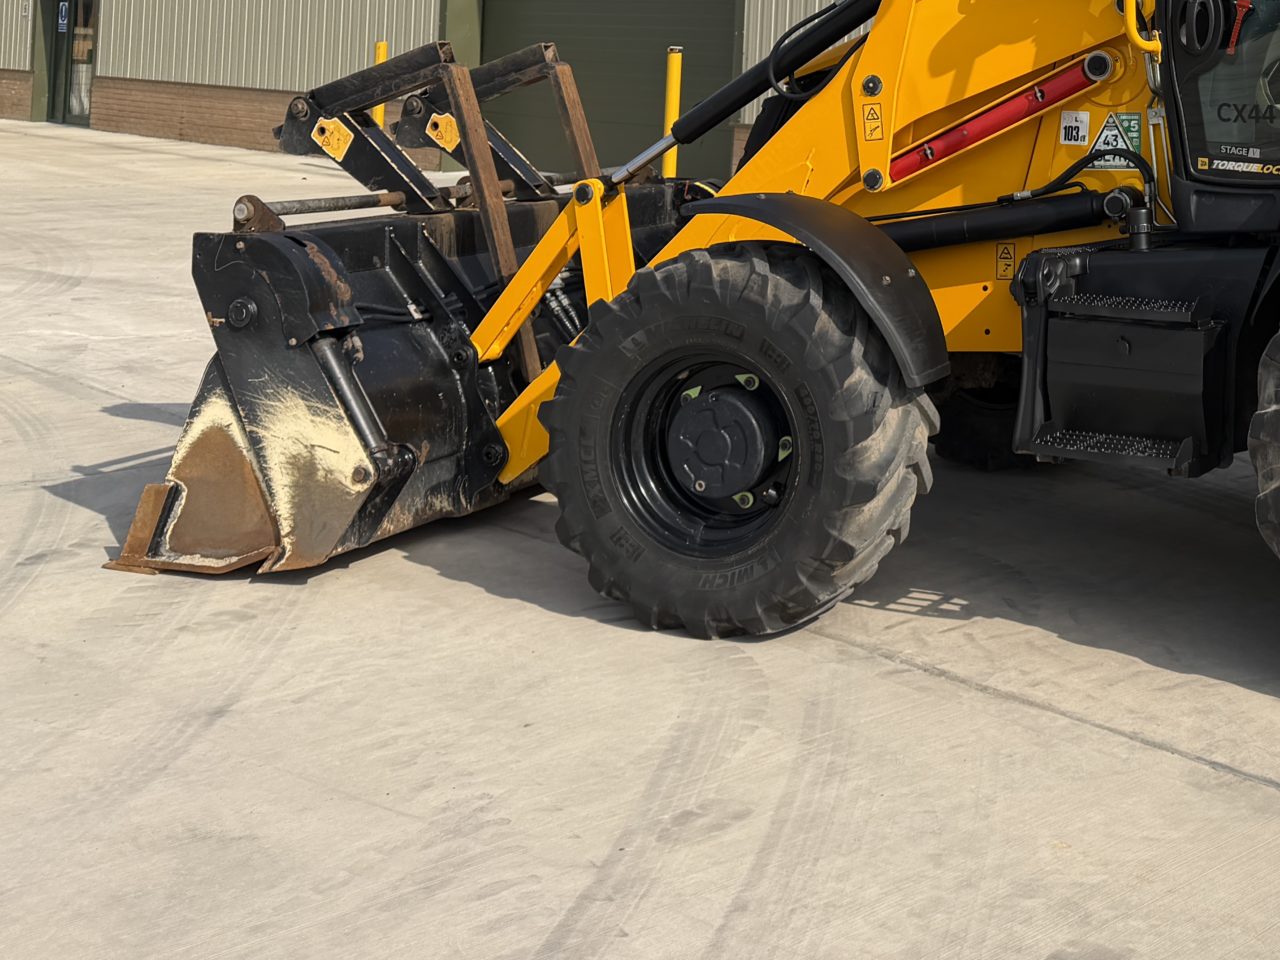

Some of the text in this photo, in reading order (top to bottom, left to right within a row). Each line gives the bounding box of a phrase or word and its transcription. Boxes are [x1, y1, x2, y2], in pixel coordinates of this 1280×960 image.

[1217, 102, 1277, 125] CX44
[1130, 120, 1138, 131] 5
[1063, 125, 1080, 142] 103
[1103, 134, 1119, 147] 43
[1220, 145, 1248, 156] STAGE
